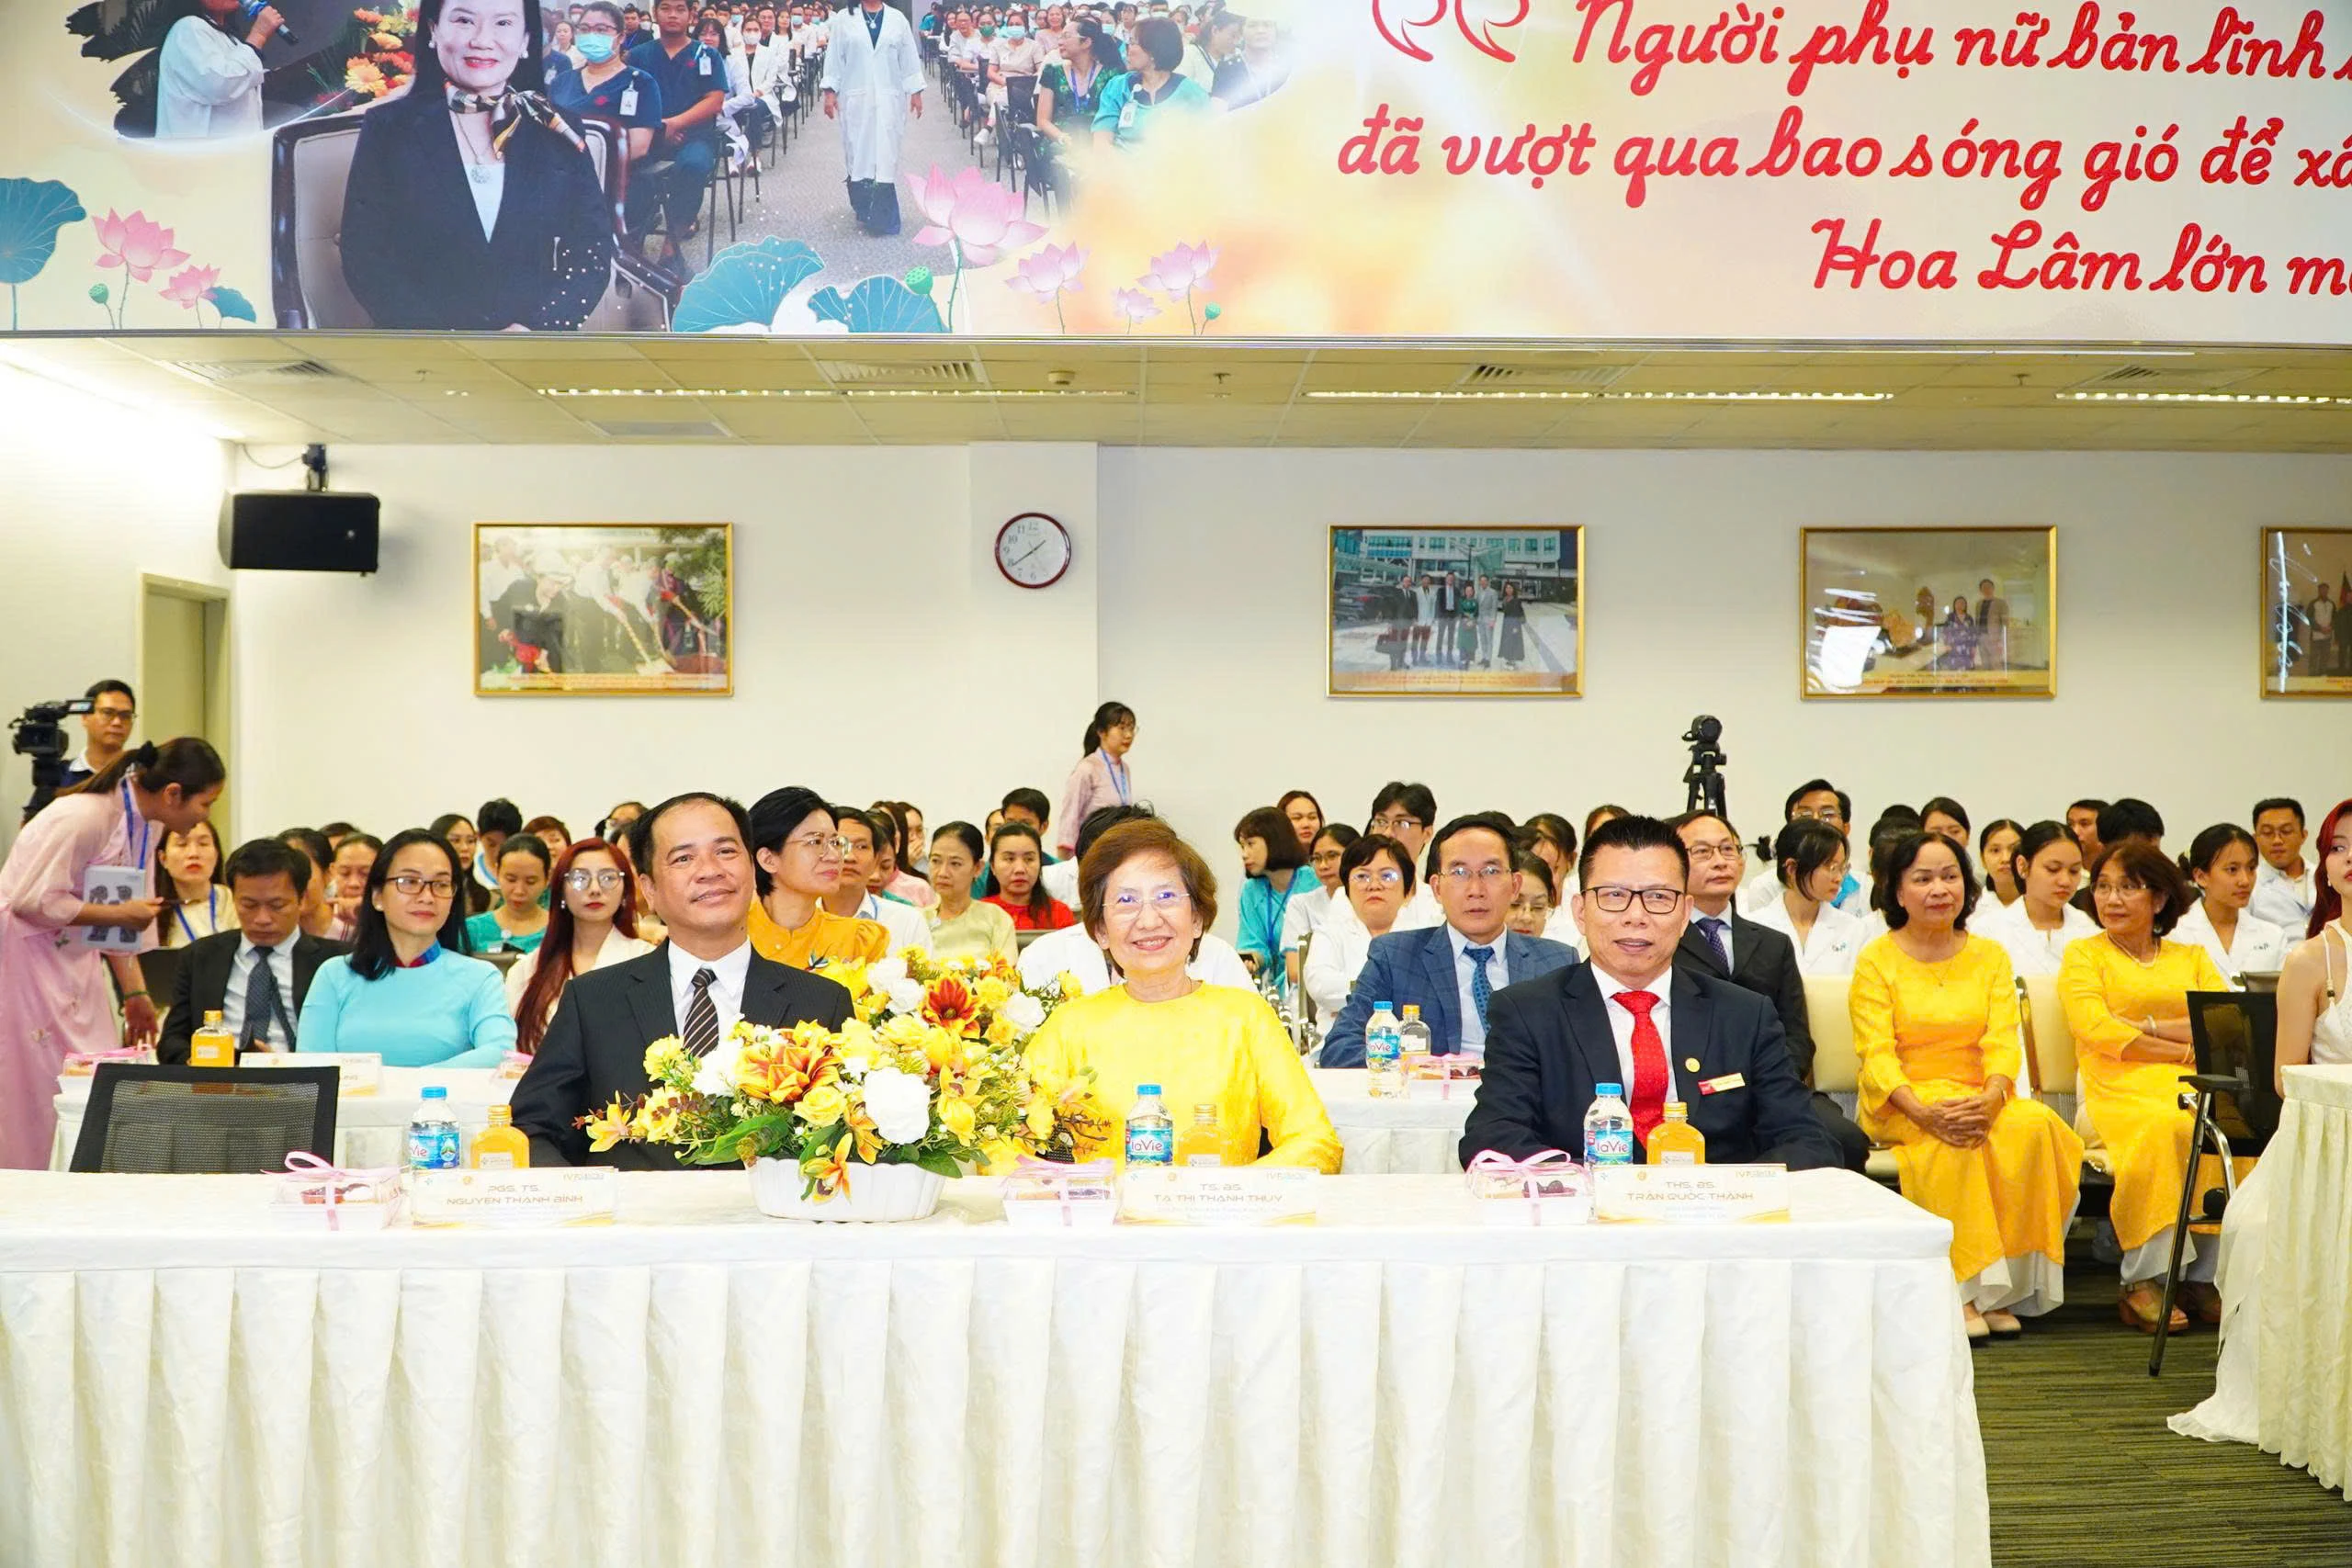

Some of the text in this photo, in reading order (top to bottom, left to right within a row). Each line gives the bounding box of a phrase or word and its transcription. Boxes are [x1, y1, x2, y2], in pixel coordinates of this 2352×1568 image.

[1574, 0, 2325, 96] Người phụ nữ bản lĩnh
[1339, 105, 1422, 174] đã
[1442, 124, 1595, 188] vượt
[1614, 138, 1738, 208] qua
[1746, 106, 1882, 176] bao
[1889, 118, 2062, 210] sóng
[2081, 124, 2178, 211] gió
[2201, 117, 2283, 184] để
[1812, 219, 1957, 289] Hoa
[1978, 220, 2142, 290] Lâm
[2150, 223, 2267, 293] lớn
